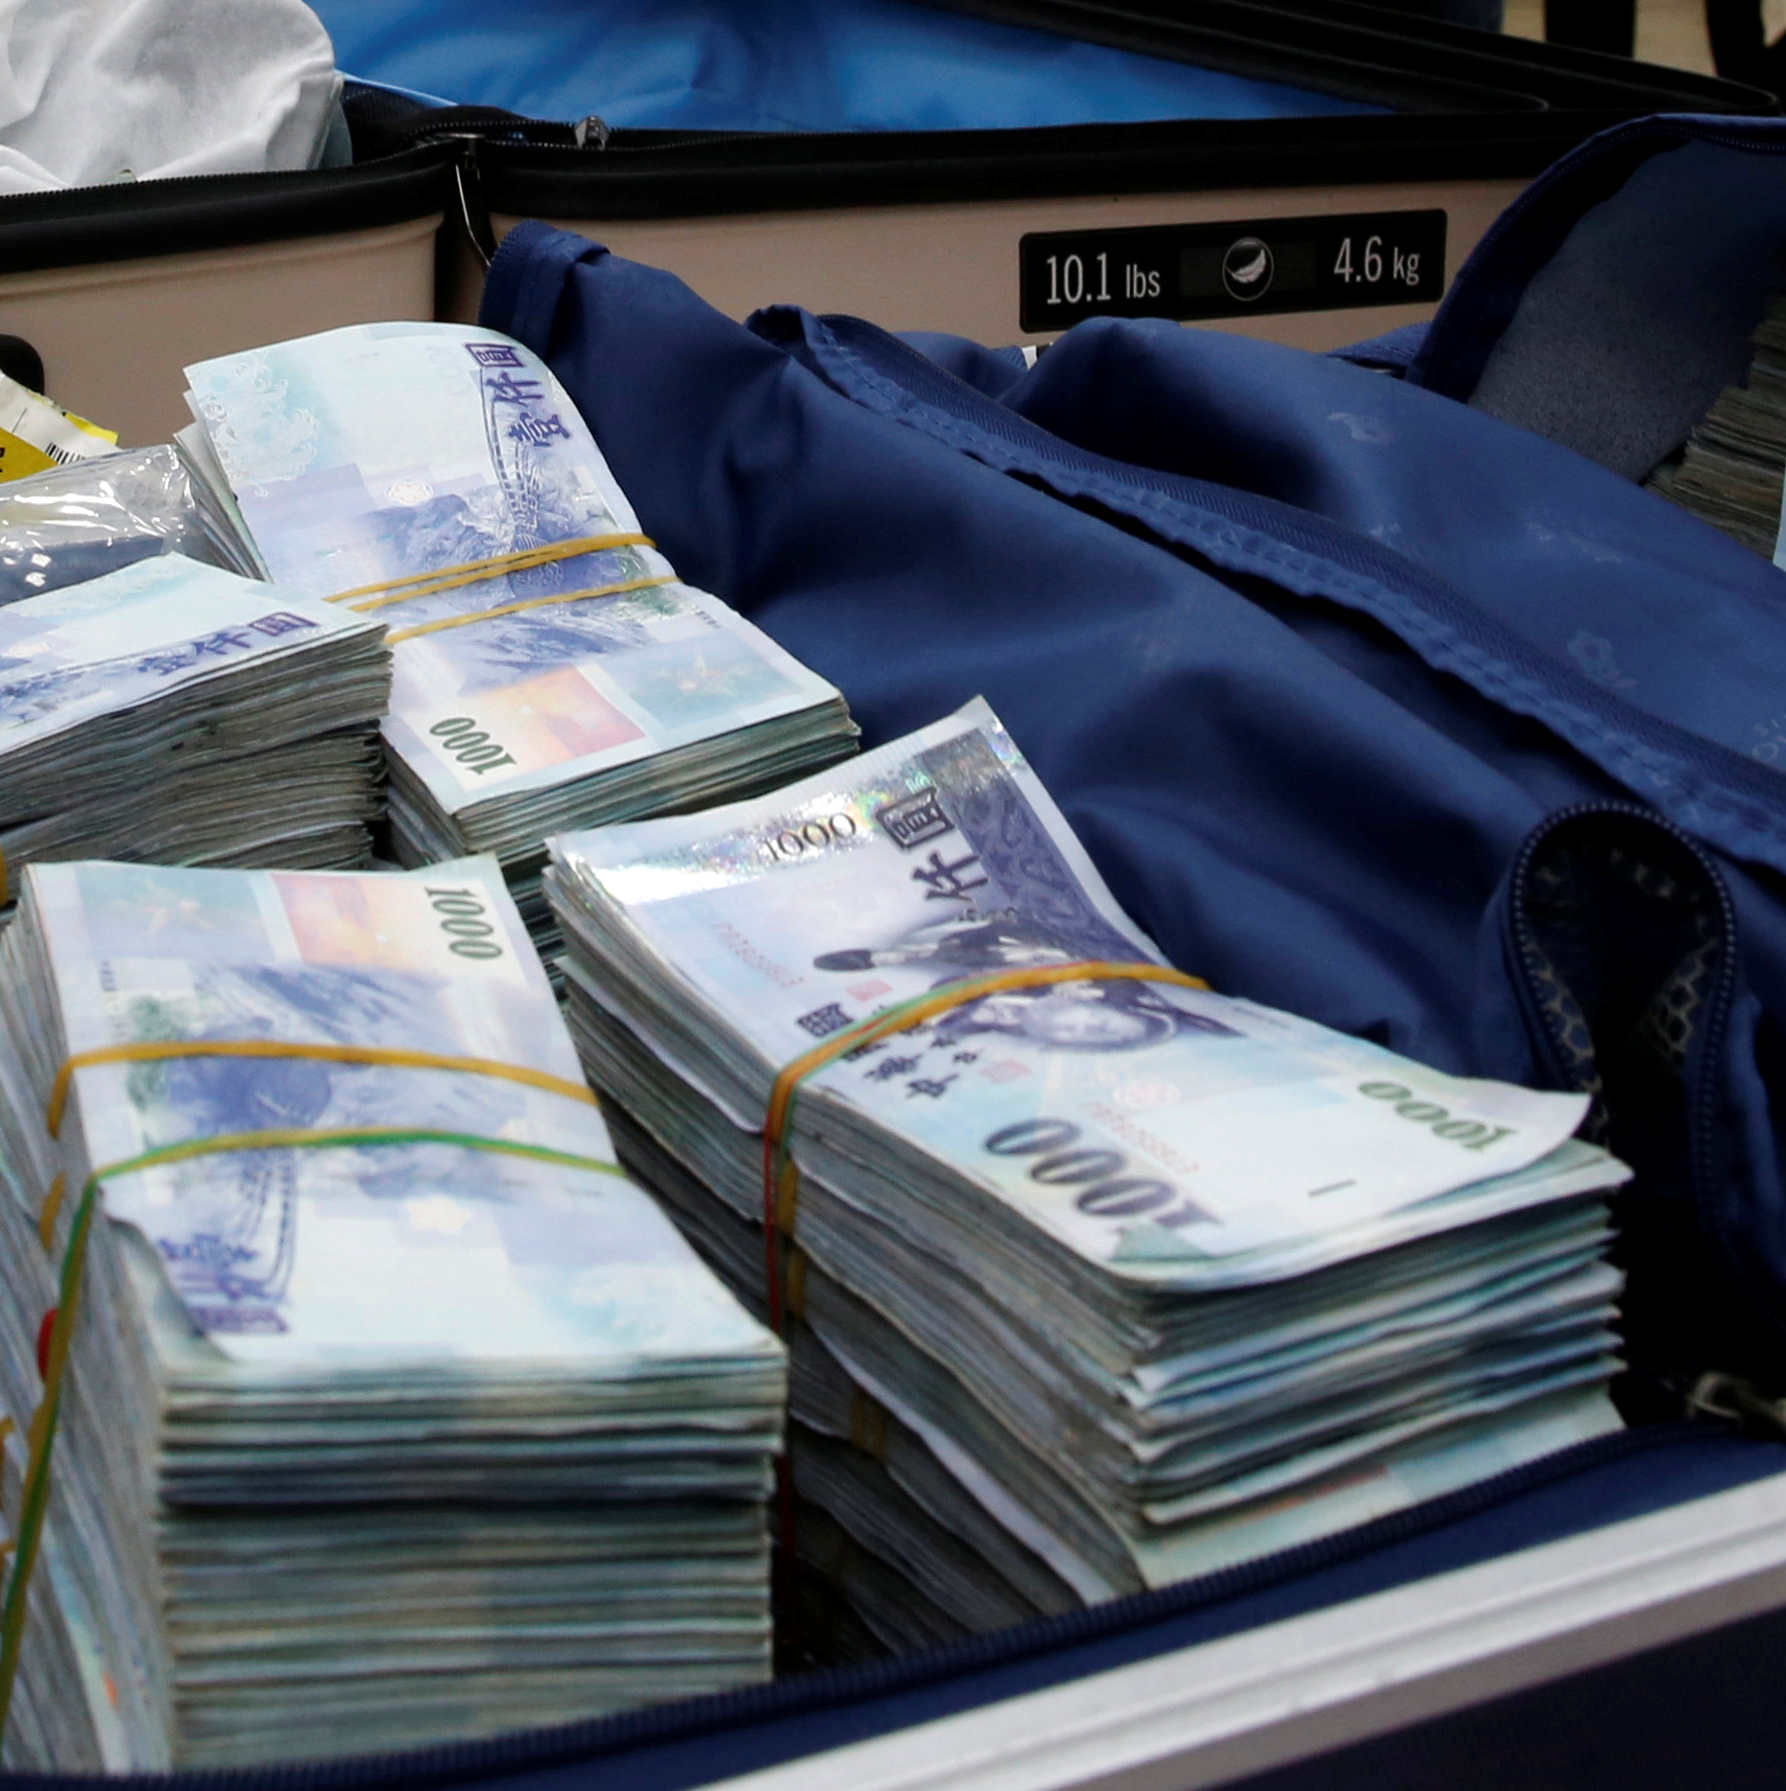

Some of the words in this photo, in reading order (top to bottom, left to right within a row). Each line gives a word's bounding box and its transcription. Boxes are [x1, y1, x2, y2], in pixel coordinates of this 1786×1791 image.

[1045, 251, 1113, 306] 10.1
[1125, 263, 1162, 300] lbs
[1332, 234, 1384, 285] 4.6
[1392, 246, 1422, 286] kg
[429, 715, 518, 776] 1000
[762, 809, 858, 868] 1000
[423, 886, 505, 962] 1000
[1357, 1079, 1519, 1155] 1000
